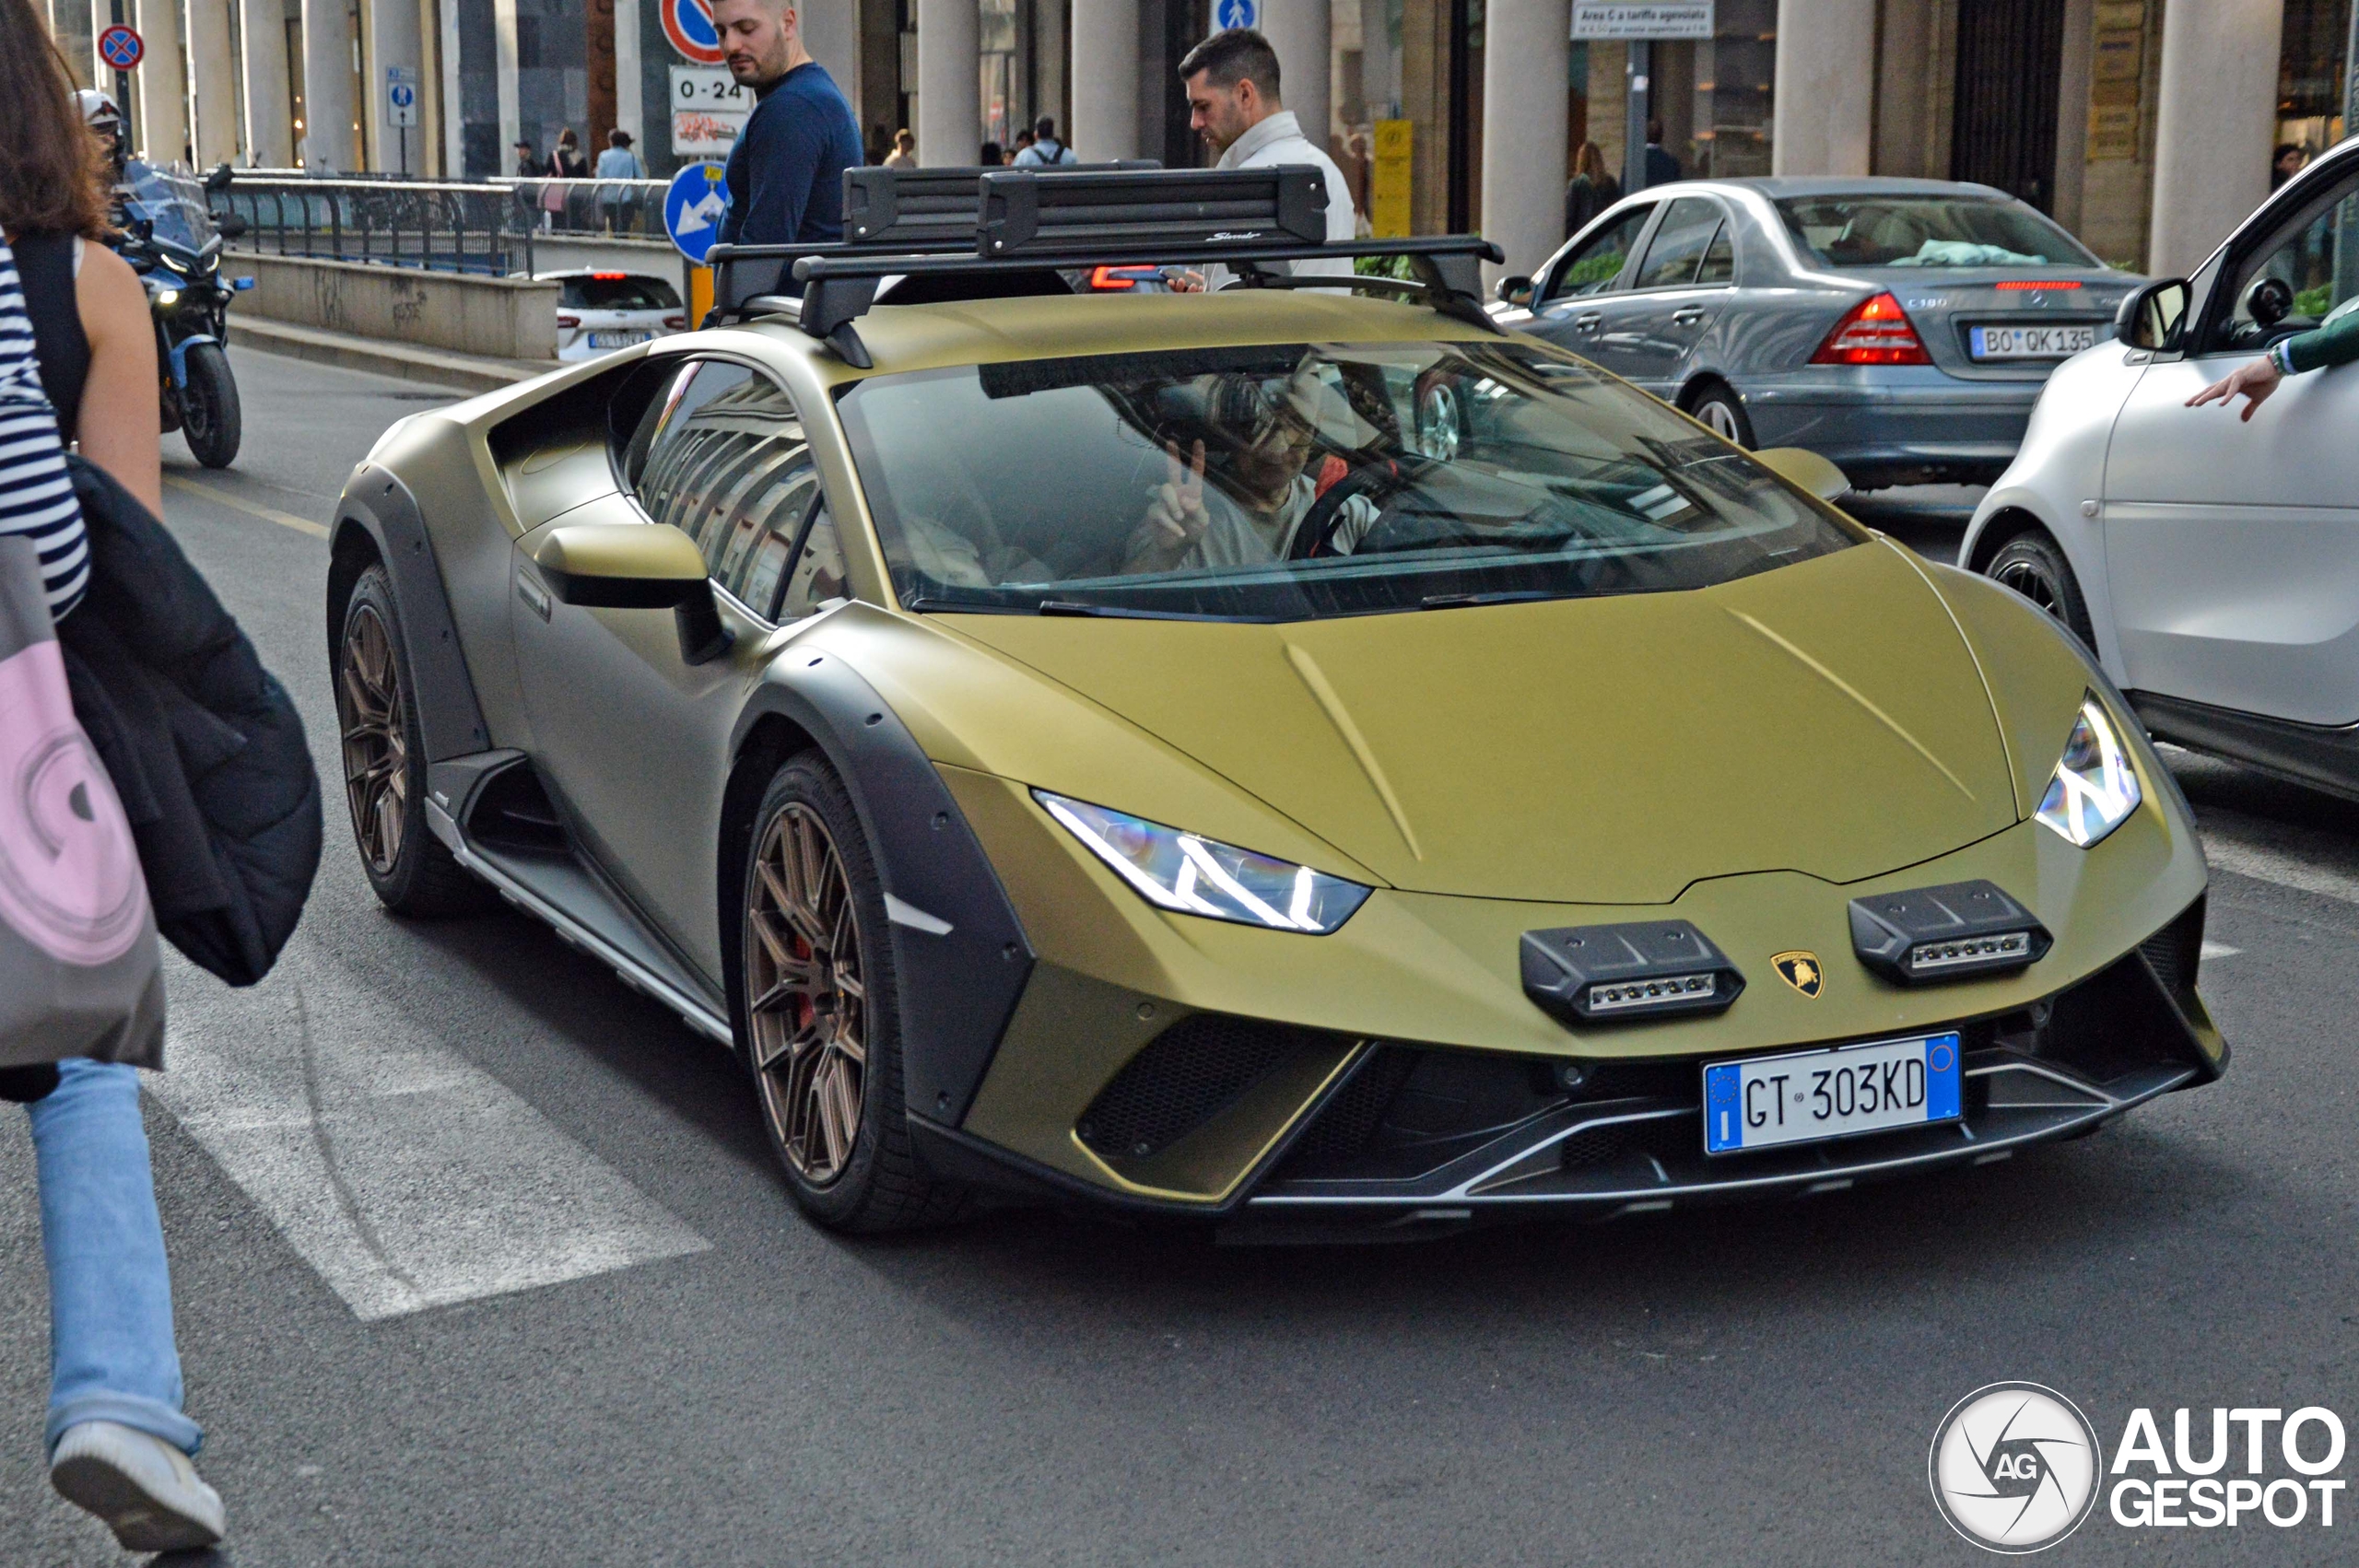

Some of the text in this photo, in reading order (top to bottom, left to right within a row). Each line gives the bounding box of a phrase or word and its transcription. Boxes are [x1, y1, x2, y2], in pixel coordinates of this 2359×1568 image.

[1581, 9, 1605, 20] Area
[1608, 9, 1614, 20] C
[680, 80, 694, 99] 0
[712, 81, 742, 99] 24
[1986, 328, 2093, 352] BO QK 135
[1745, 1074, 1790, 1129] GT
[1811, 1058, 1926, 1120] 303KD
